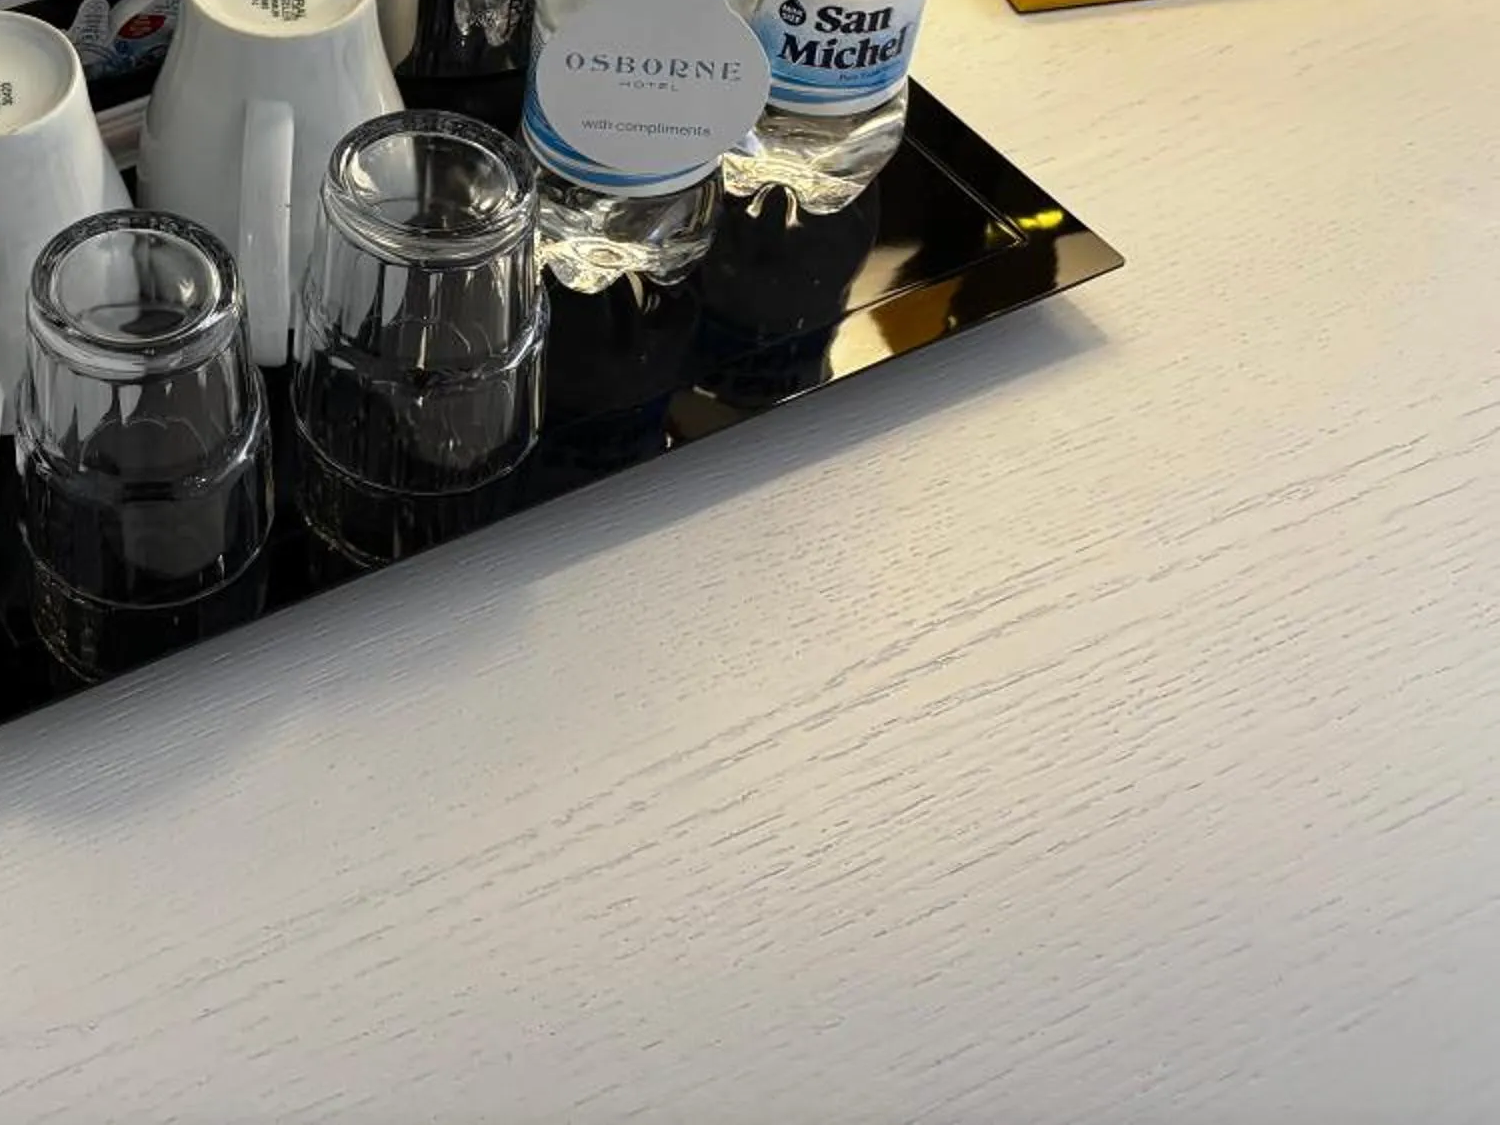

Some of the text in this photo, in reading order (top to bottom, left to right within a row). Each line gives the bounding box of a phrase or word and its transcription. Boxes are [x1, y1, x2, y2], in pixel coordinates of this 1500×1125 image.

[815, 5, 894, 34] San
[777, 22, 913, 70] Michel
[565, 51, 742, 82] OSBORNE
[619, 81, 680, 92] HOTEL
[582, 119, 712, 138] with compliments
